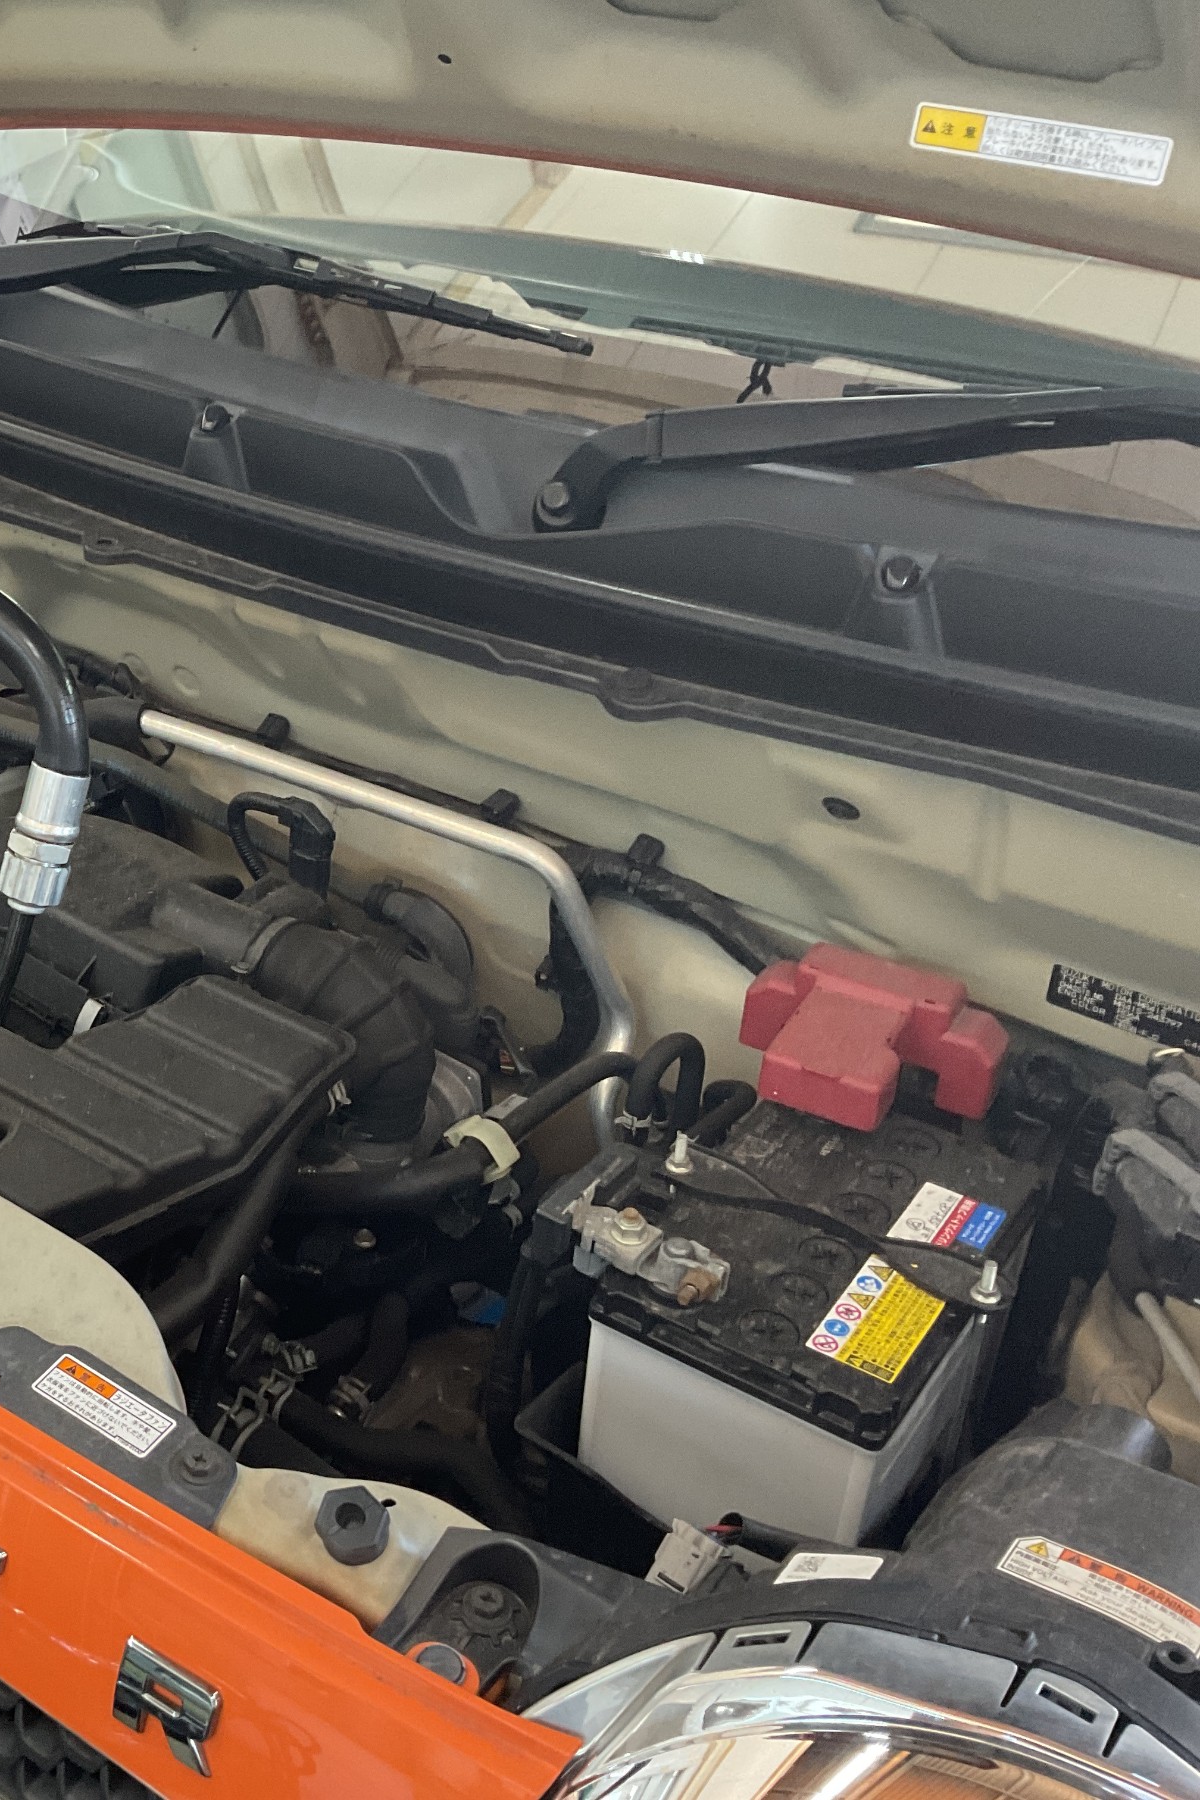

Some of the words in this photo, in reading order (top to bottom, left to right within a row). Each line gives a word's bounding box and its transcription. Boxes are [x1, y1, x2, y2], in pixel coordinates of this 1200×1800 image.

[1071, 998, 1106, 1015] COLOR
[115, 1393, 168, 1430] ラジエータファン
[1135, 1582, 1195, 1620] WARNING
